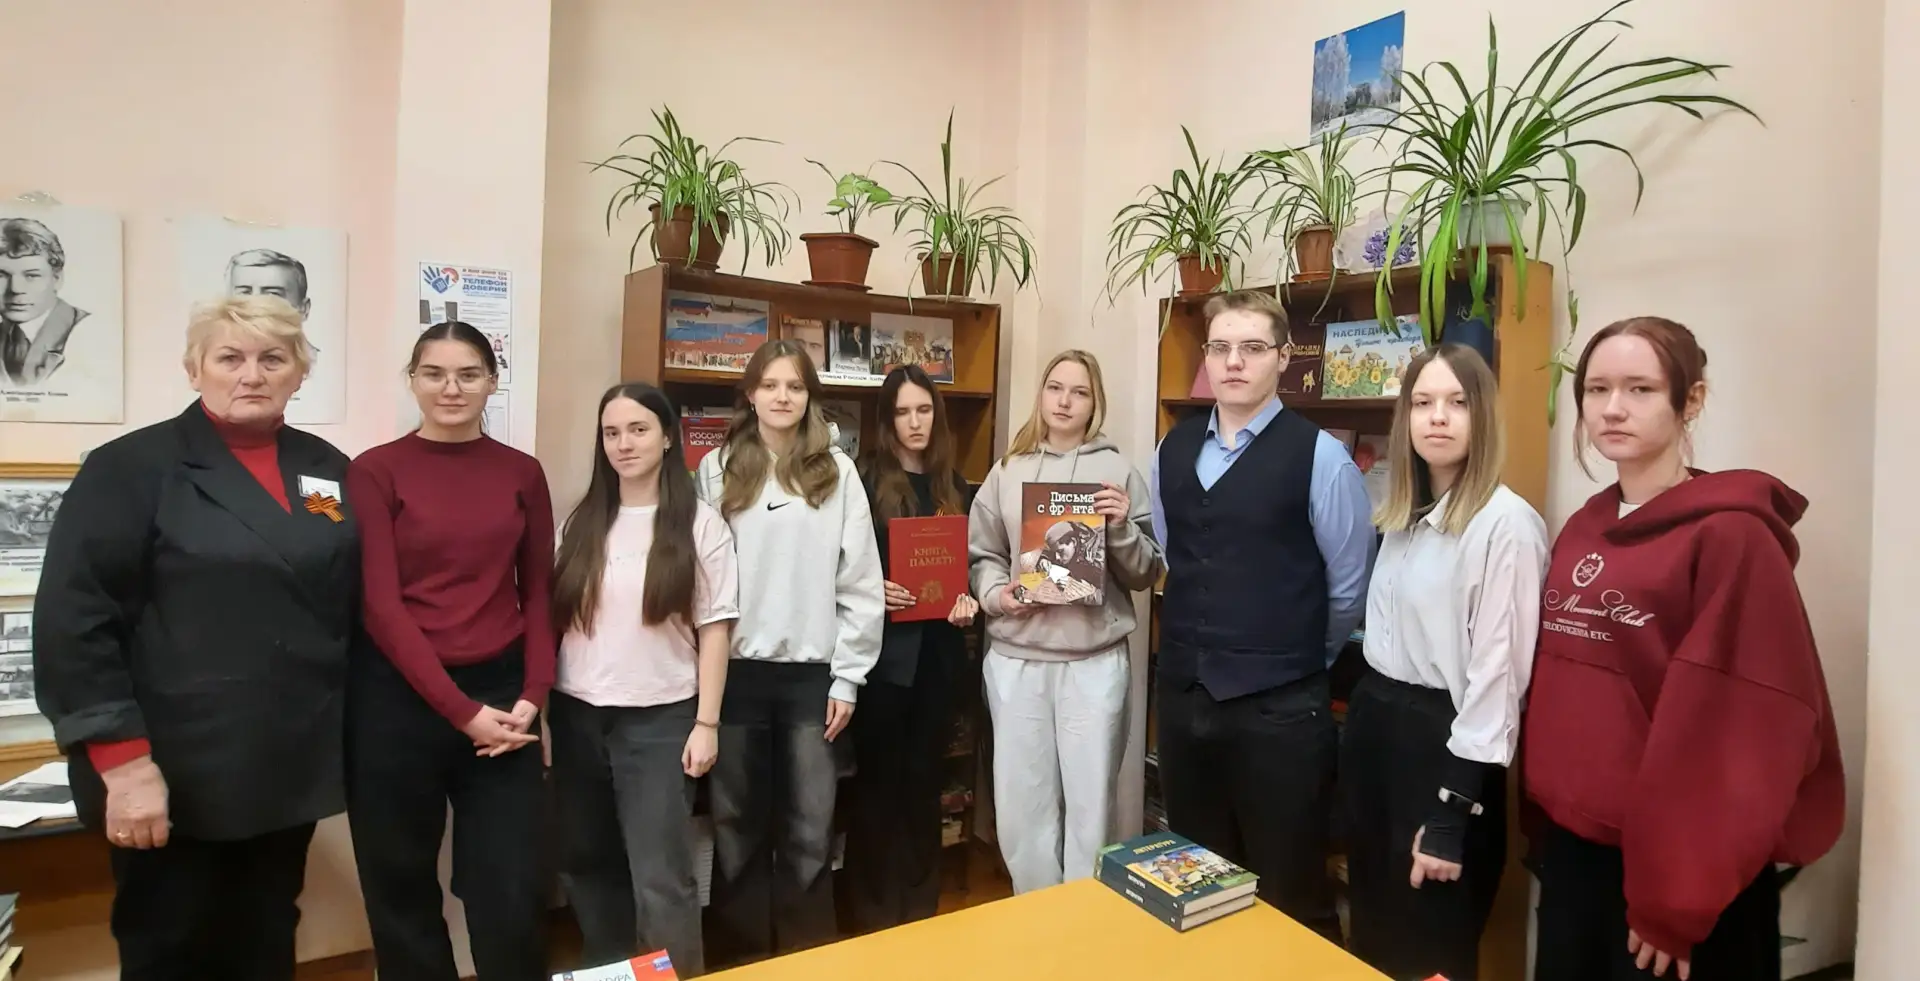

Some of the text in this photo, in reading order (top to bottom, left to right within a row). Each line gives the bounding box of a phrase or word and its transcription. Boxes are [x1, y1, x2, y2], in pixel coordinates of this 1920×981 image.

[1333, 327, 1386, 338] НАСЛЕДИ
[689, 432, 723, 440] РОССИЯ
[1051, 491, 1095, 503] Письма
[1037, 504, 1045, 514] с
[1601, 589, 1655, 627] Club
